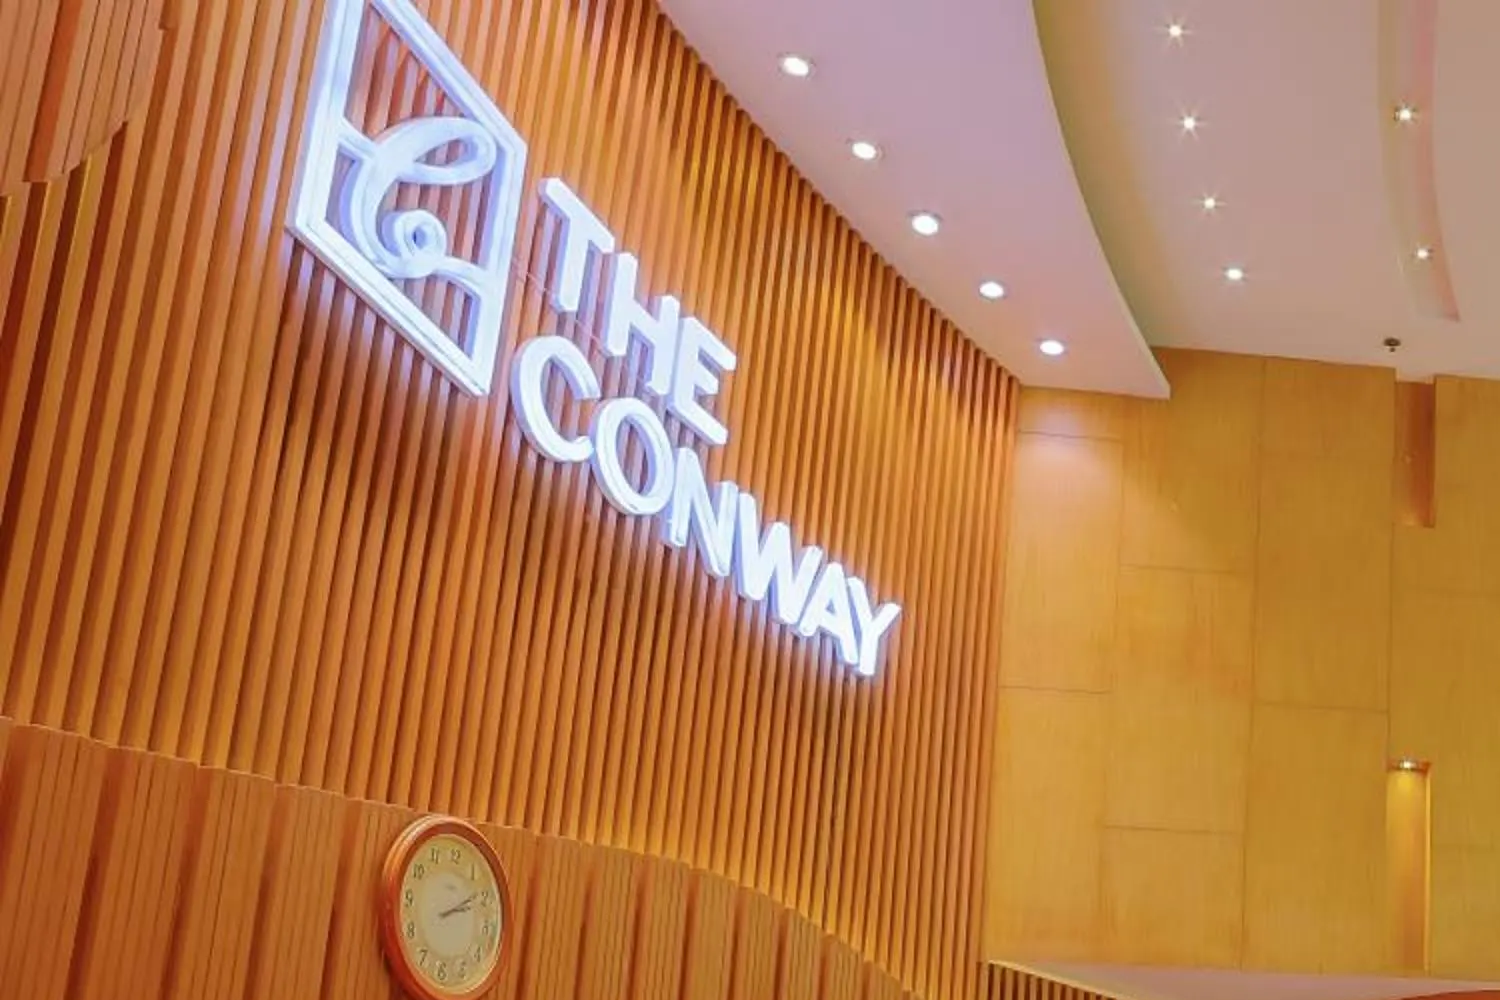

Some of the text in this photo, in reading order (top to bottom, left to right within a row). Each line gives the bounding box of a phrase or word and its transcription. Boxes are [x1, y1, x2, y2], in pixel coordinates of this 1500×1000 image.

[539, 177, 737, 445] THE
[509, 334, 902, 677] CONWAY
[430, 848, 440, 864] 11
[451, 848, 461, 865] 12
[413, 863, 425, 880] 10
[405, 890, 413, 908] 9
[481, 891, 489, 906] 2
[407, 922, 415, 939] 8
[419, 948, 428, 967] 7
[437, 962, 447, 981] 6
